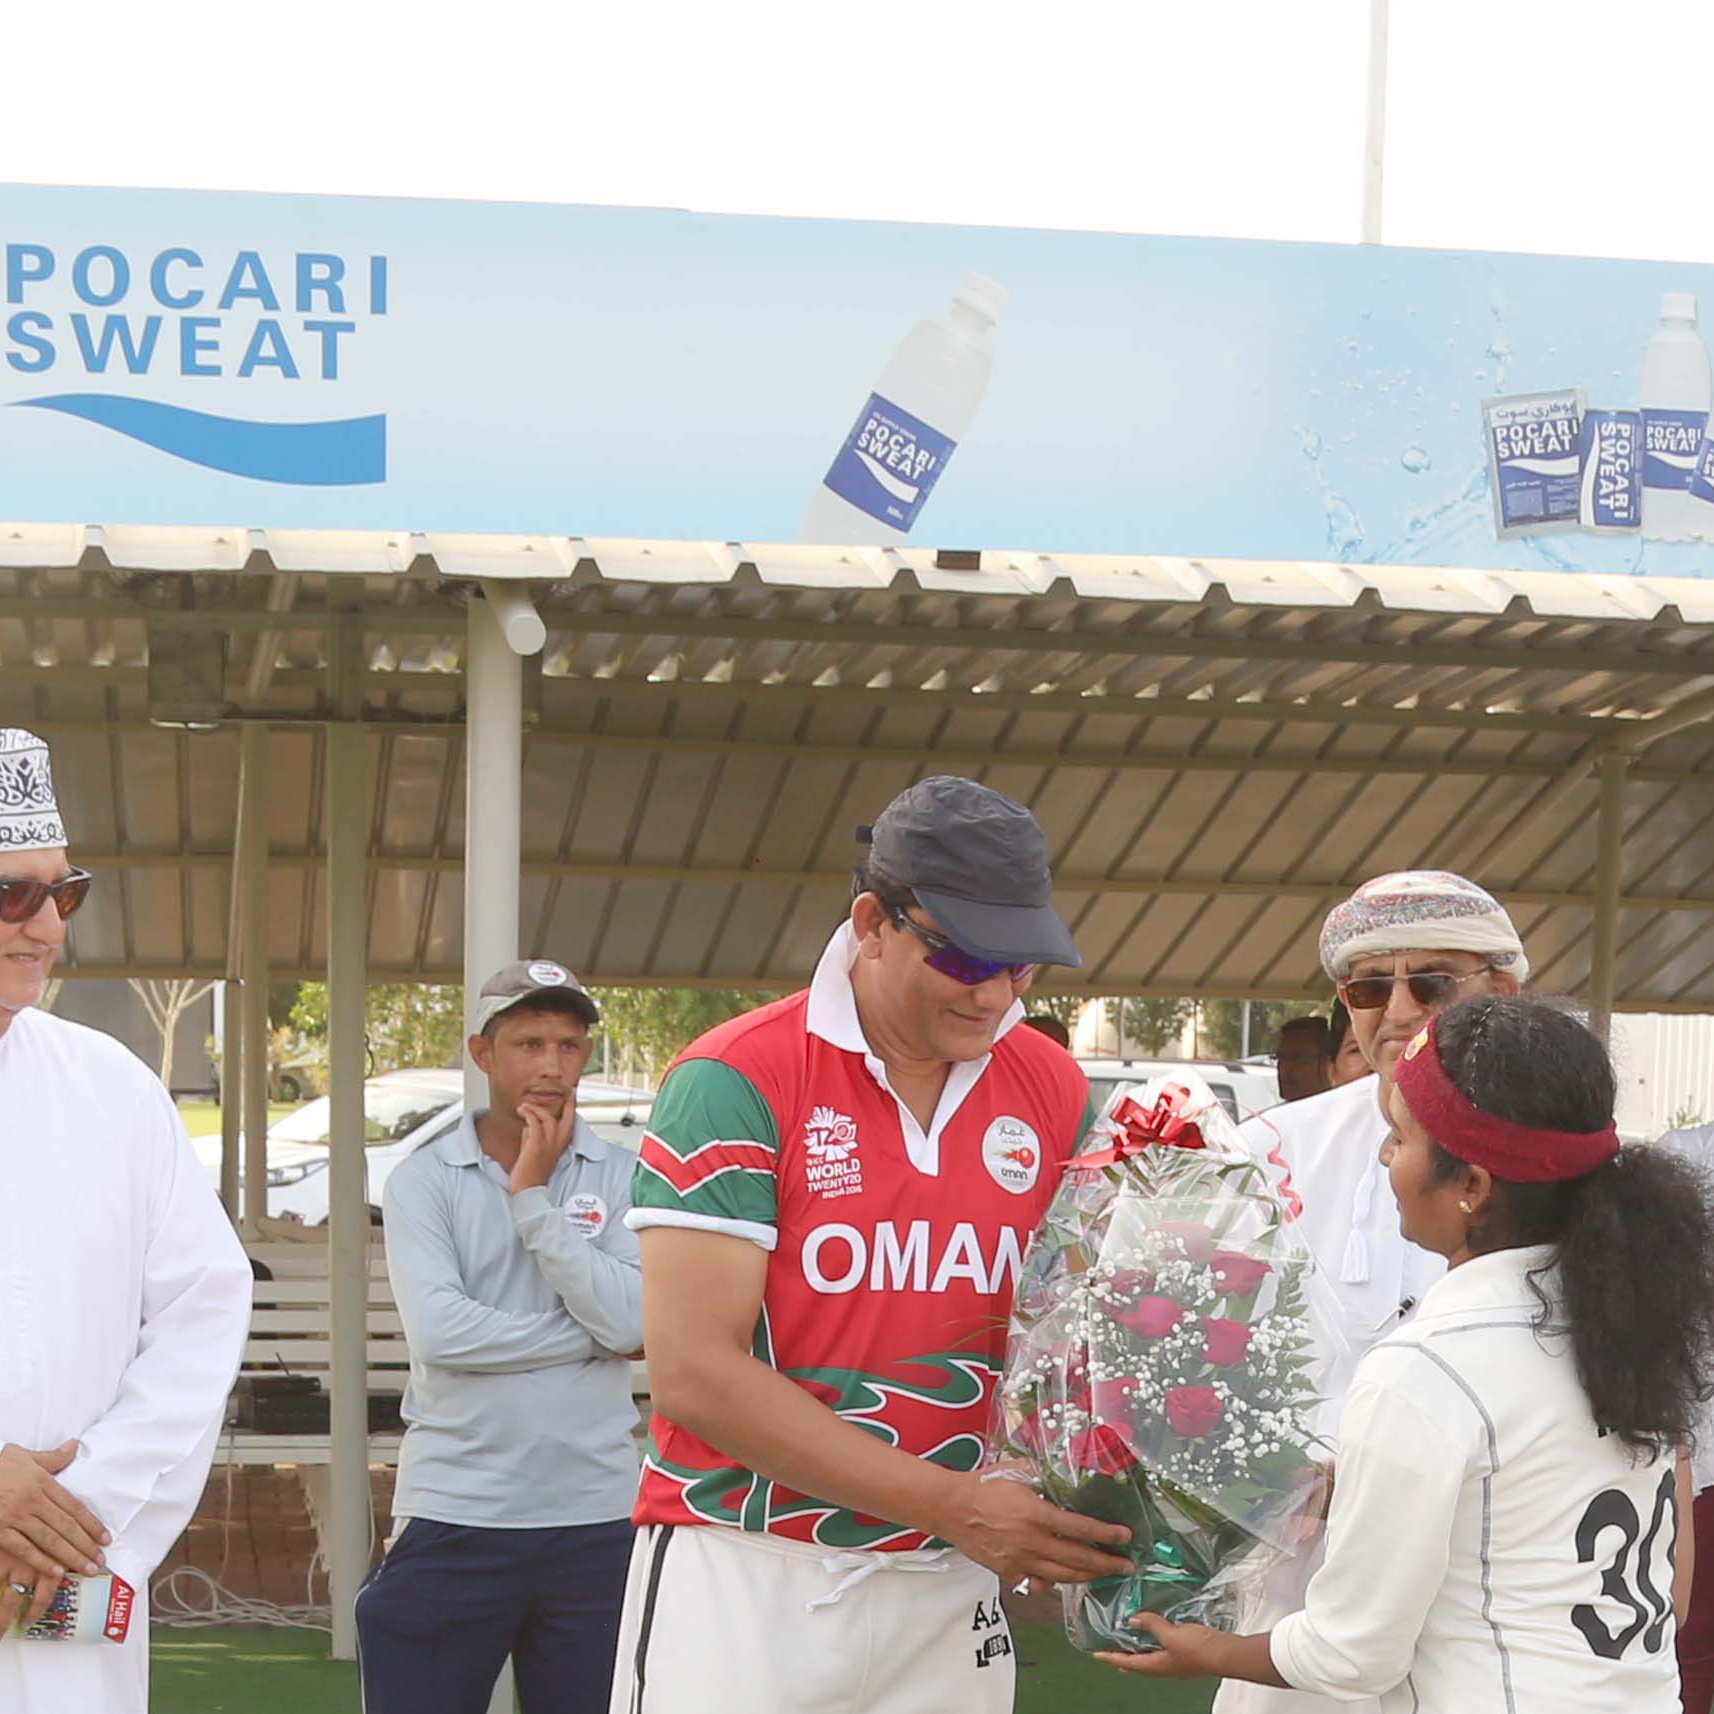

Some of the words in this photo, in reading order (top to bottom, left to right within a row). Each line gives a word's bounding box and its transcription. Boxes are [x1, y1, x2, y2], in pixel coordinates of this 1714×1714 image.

[6, 243, 388, 315] POCARI
[5, 311, 356, 380] SWEAT
[865, 418, 937, 470] POCARI
[1496, 419, 1578, 442] POCARI
[1498, 434, 1571, 458] SWEAT
[1646, 426, 1701, 440] POCARI
[1646, 438, 1696, 451] SWEAT
[857, 433, 925, 480] SWEAT
[1599, 422, 1616, 510] SWEAT
[1613, 423, 1631, 519] POCARI
[806, 1158, 861, 1181] WORLD
[807, 1174, 862, 1193] TWENTY20
